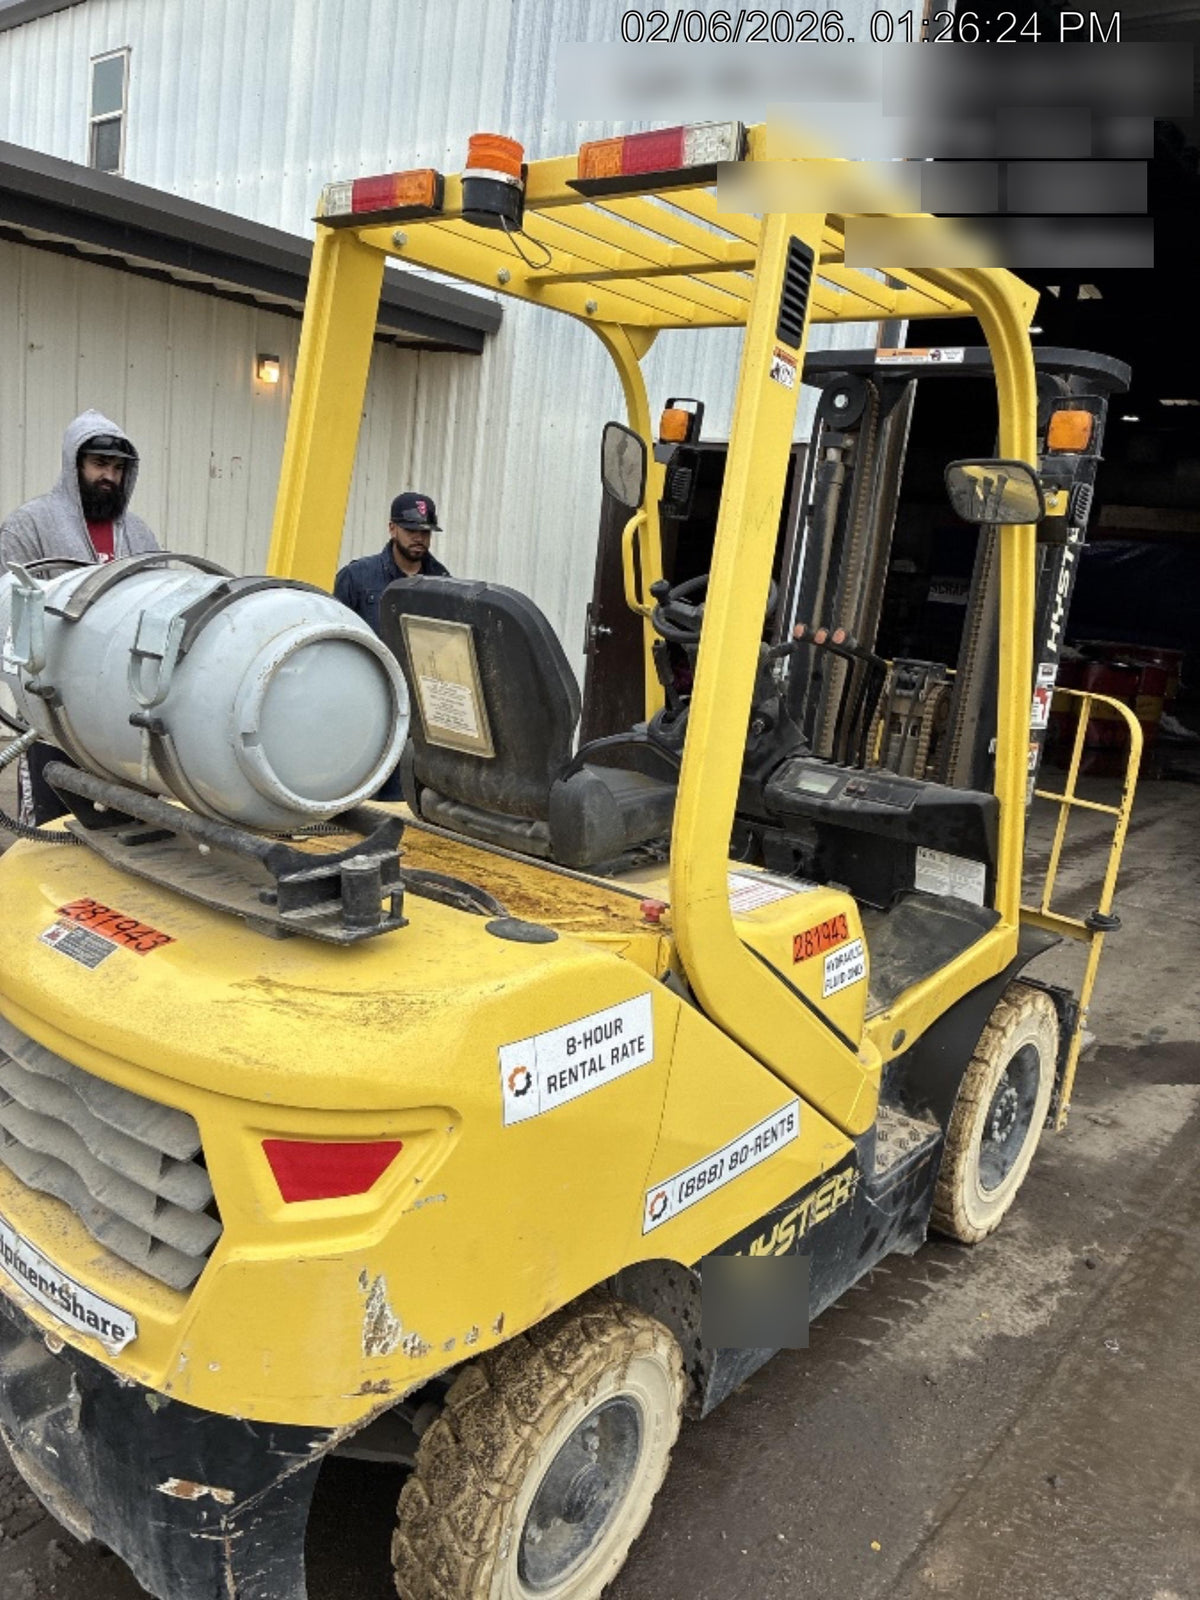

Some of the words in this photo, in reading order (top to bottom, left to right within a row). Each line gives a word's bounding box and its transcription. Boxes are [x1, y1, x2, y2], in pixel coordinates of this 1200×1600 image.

[58, 899, 172, 952] 281943
[794, 913, 848, 963] 281943
[547, 1054, 606, 1094] RENTAL
[611, 1035, 646, 1066] RATE
[566, 1017, 624, 1056] 8-HOUR
[678, 1158, 724, 1203] (888)
[728, 1112, 795, 1172] 80-RENTS
[735, 1167, 855, 1256] YSTER
